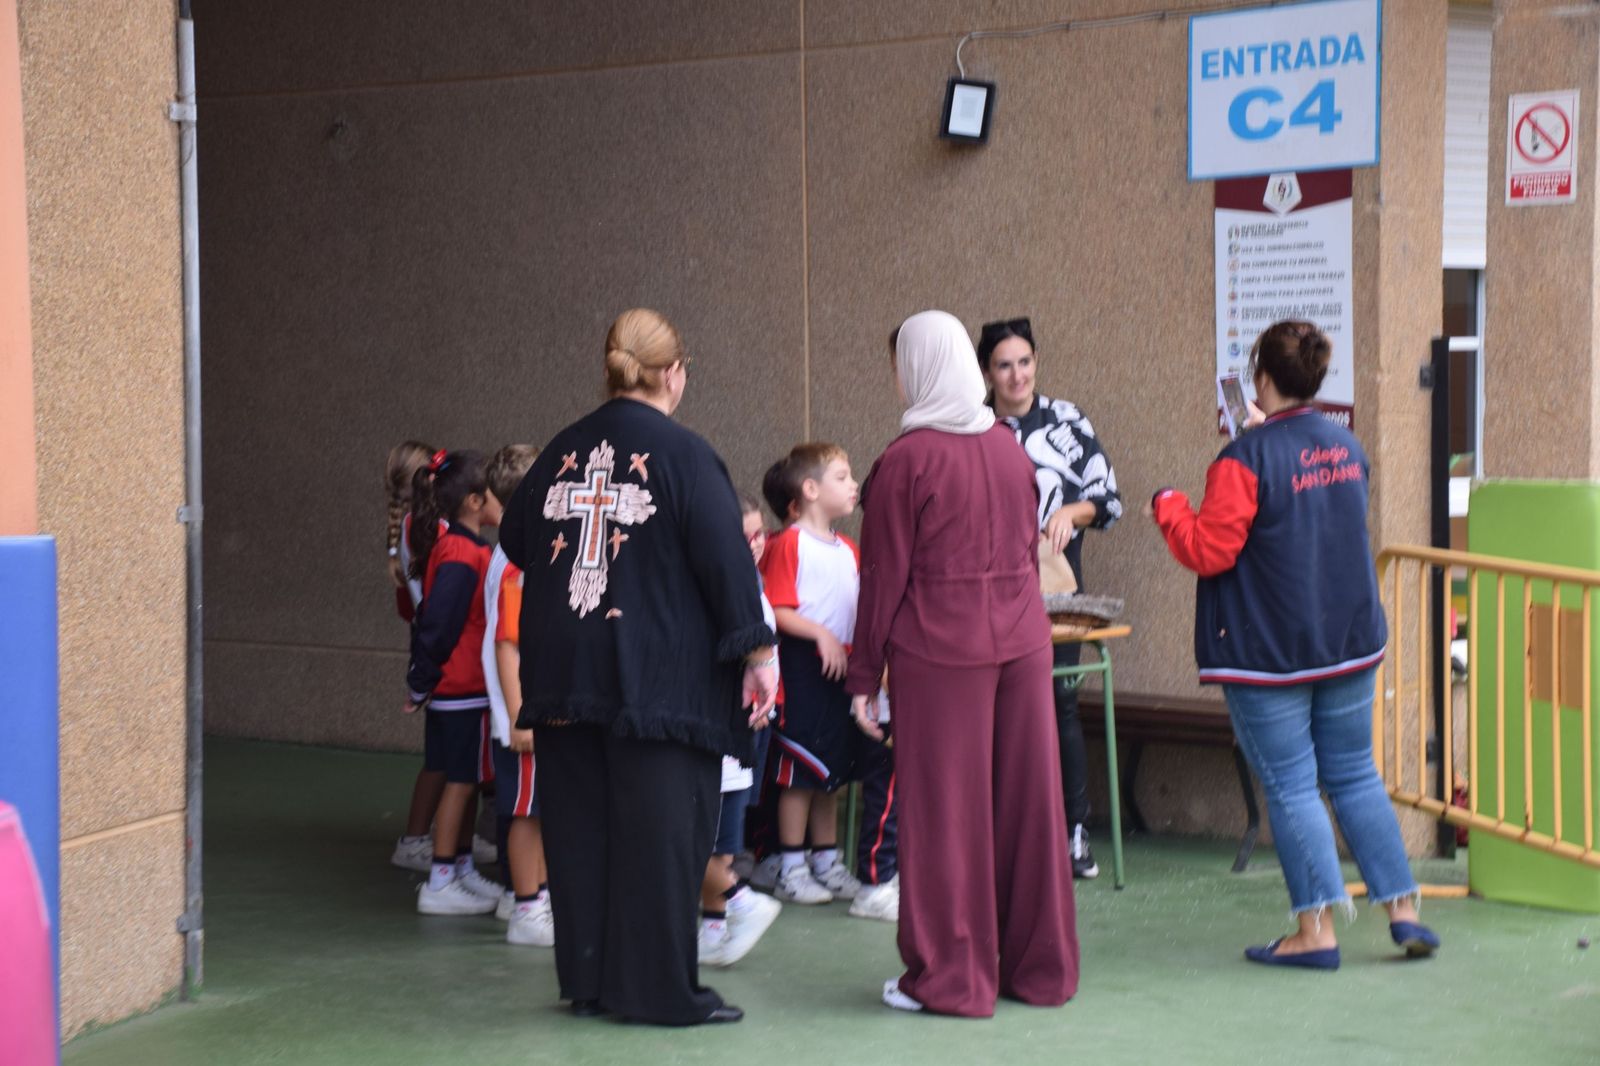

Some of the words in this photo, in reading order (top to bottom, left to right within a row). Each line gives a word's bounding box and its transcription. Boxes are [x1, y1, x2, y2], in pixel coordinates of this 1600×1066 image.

[1201, 32, 1365, 80] ENTRADA
[1228, 78, 1343, 141] C4
[1300, 443, 1349, 468] Colegio
[1319, 462, 1362, 487] DANIE
